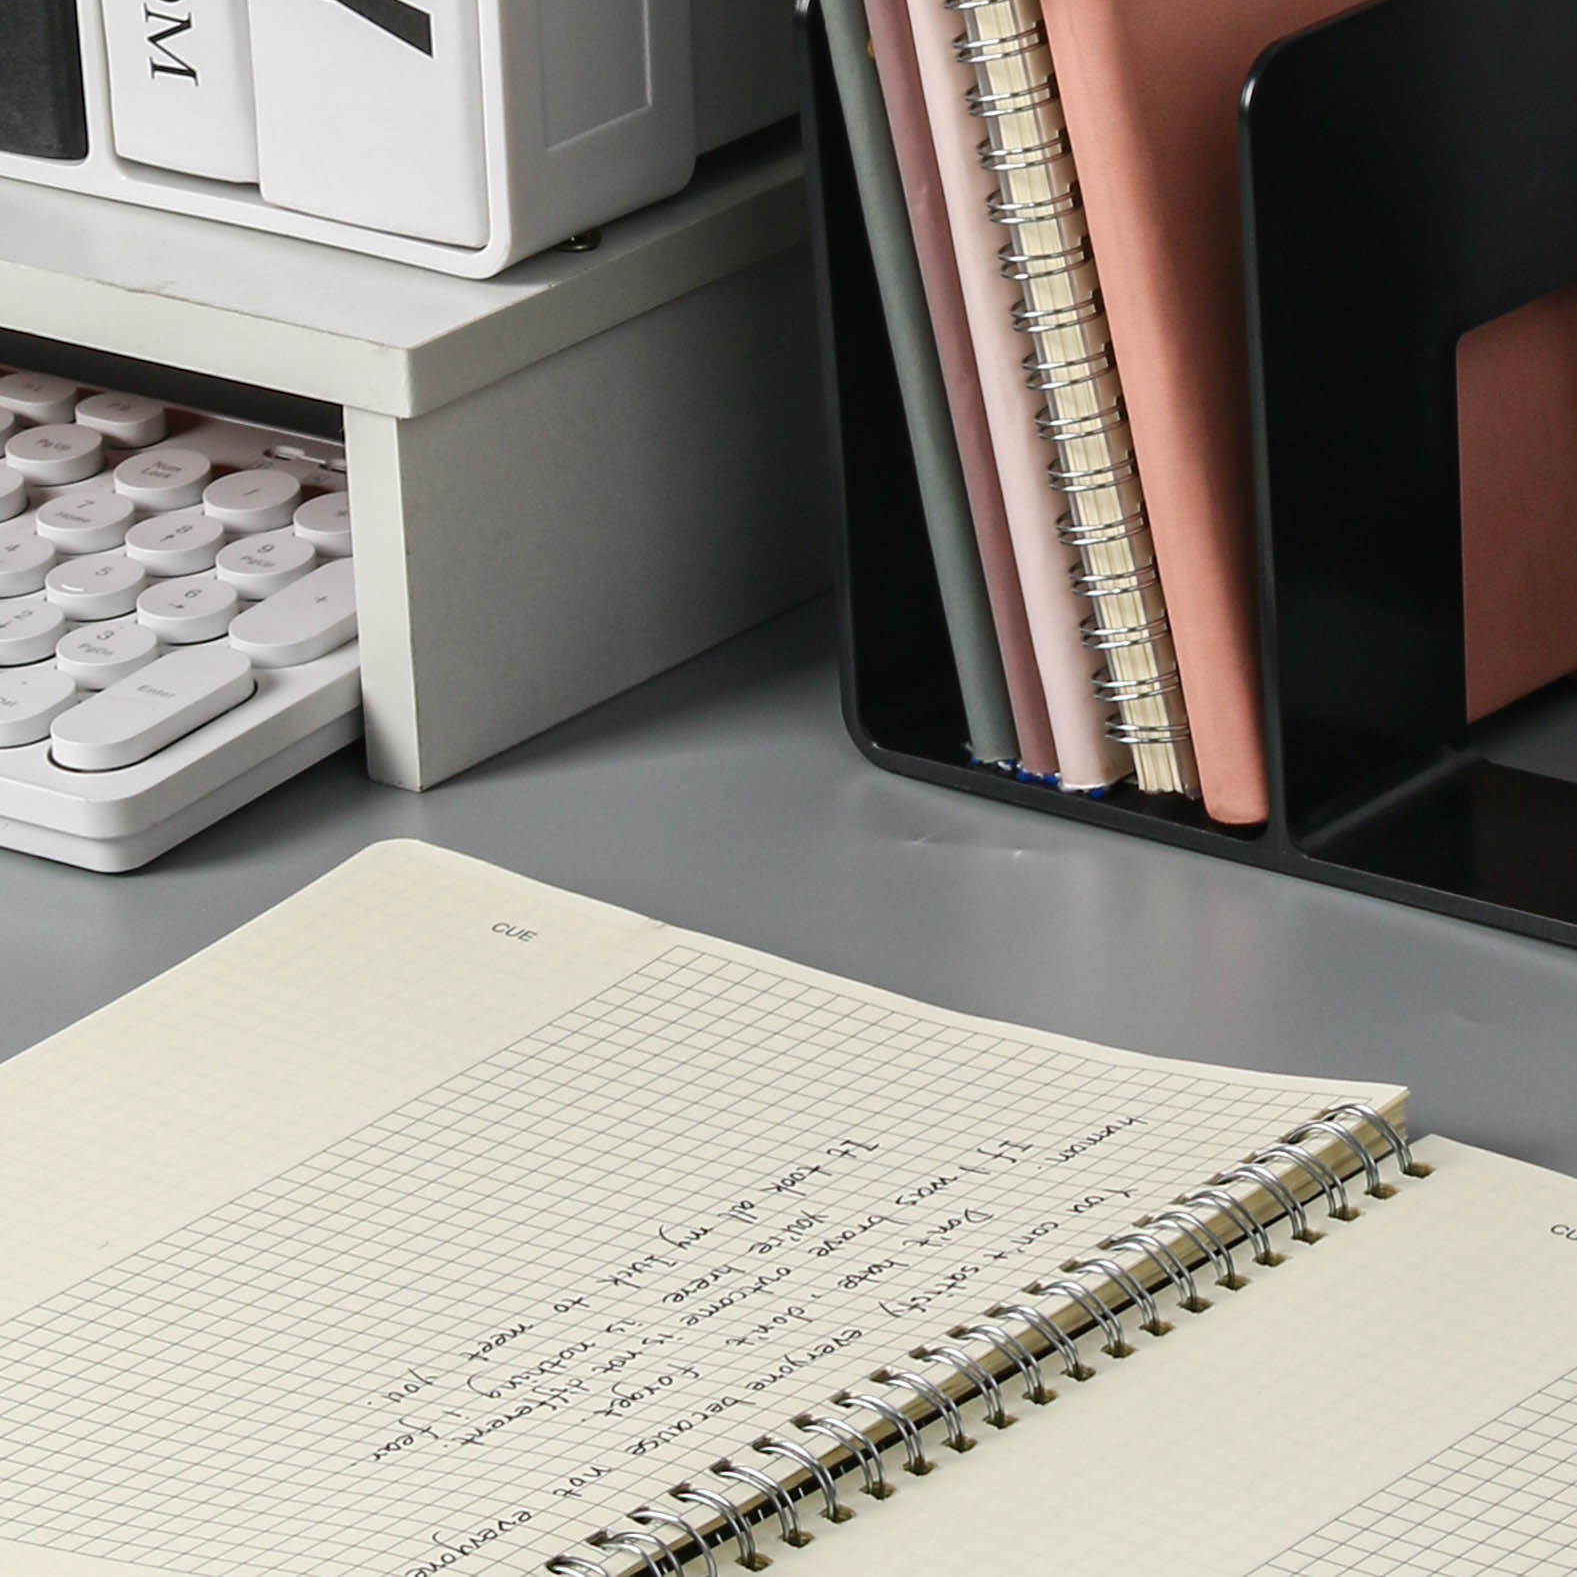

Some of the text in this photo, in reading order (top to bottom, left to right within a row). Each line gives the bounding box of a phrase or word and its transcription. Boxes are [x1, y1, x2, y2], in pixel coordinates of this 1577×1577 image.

[491, 922, 537, 942] CUE
[759, 1165, 833, 1196] took
[895, 1176, 959, 1206] was
[716, 1199, 759, 1224] all
[1066, 1188, 1138, 1213] You
[659, 1224, 714, 1250] my
[553, 1296, 591, 1315] to
[458, 1323, 534, 1362] meet
[746, 1328, 862, 1392] everyone
[626, 1396, 756, 1456] because
[552, 1466, 613, 1497] not
